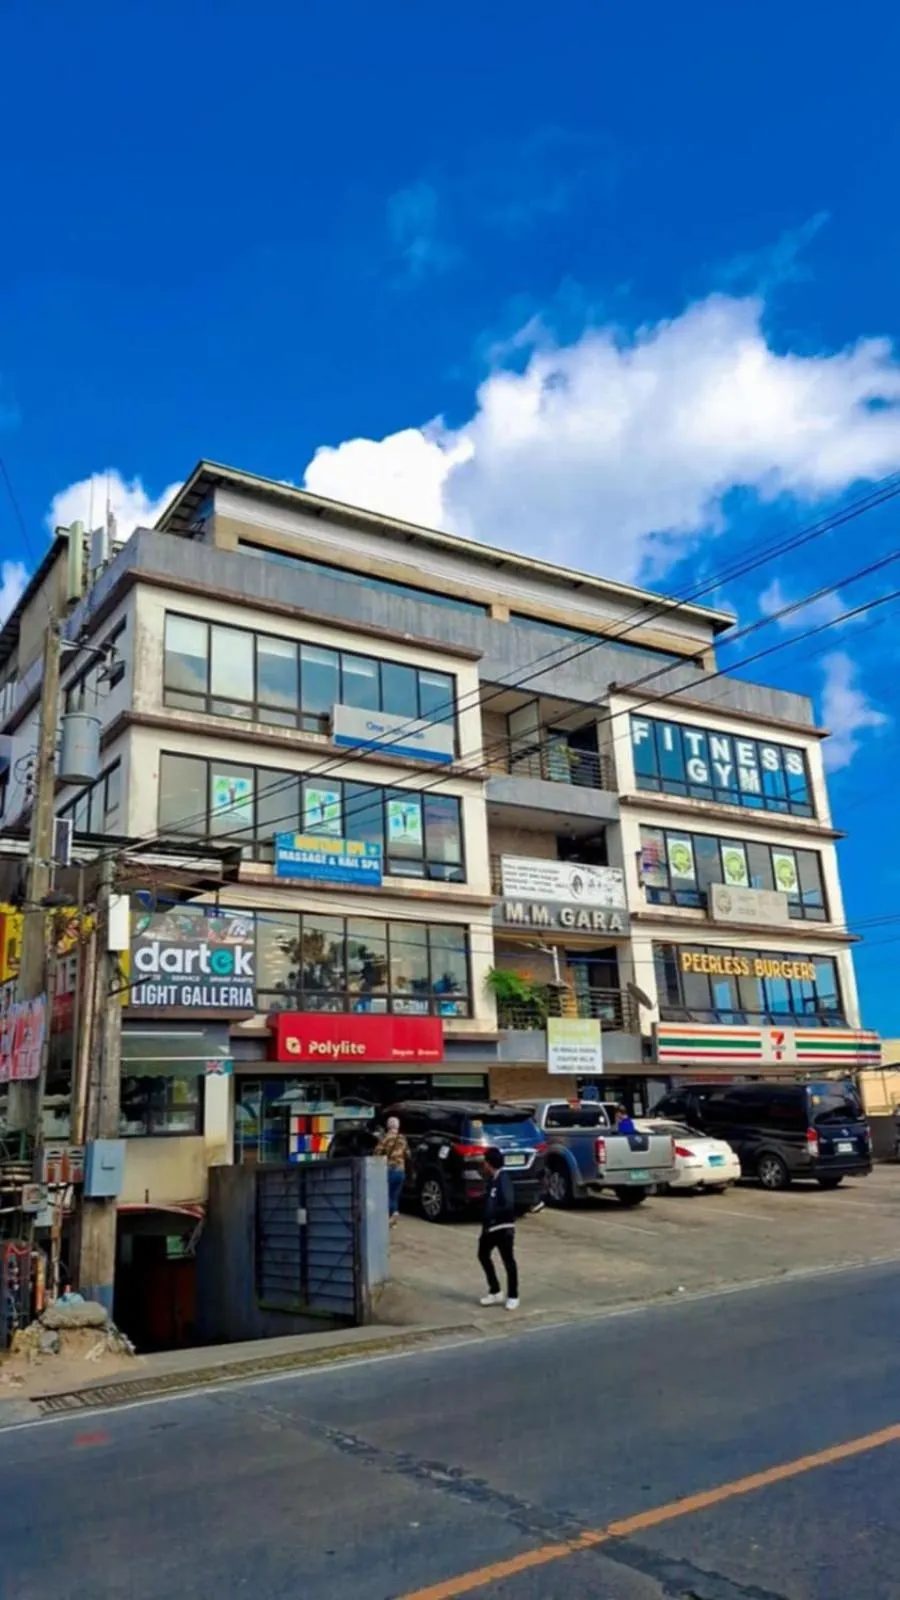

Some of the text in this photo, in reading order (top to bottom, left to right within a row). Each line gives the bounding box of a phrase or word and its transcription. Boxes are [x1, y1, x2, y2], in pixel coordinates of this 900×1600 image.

[632, 721, 804, 775] FITNESS
[687, 758, 760, 794] GYM
[361, 859, 380, 871] SPA
[505, 901, 623, 931] M.M. GARA
[134, 941, 255, 976] dartek
[681, 952, 817, 981] PEERLESS BURGERS
[131, 984, 255, 1008] LIGHT GALLERIA
[308, 1039, 366, 1060] Polylite
